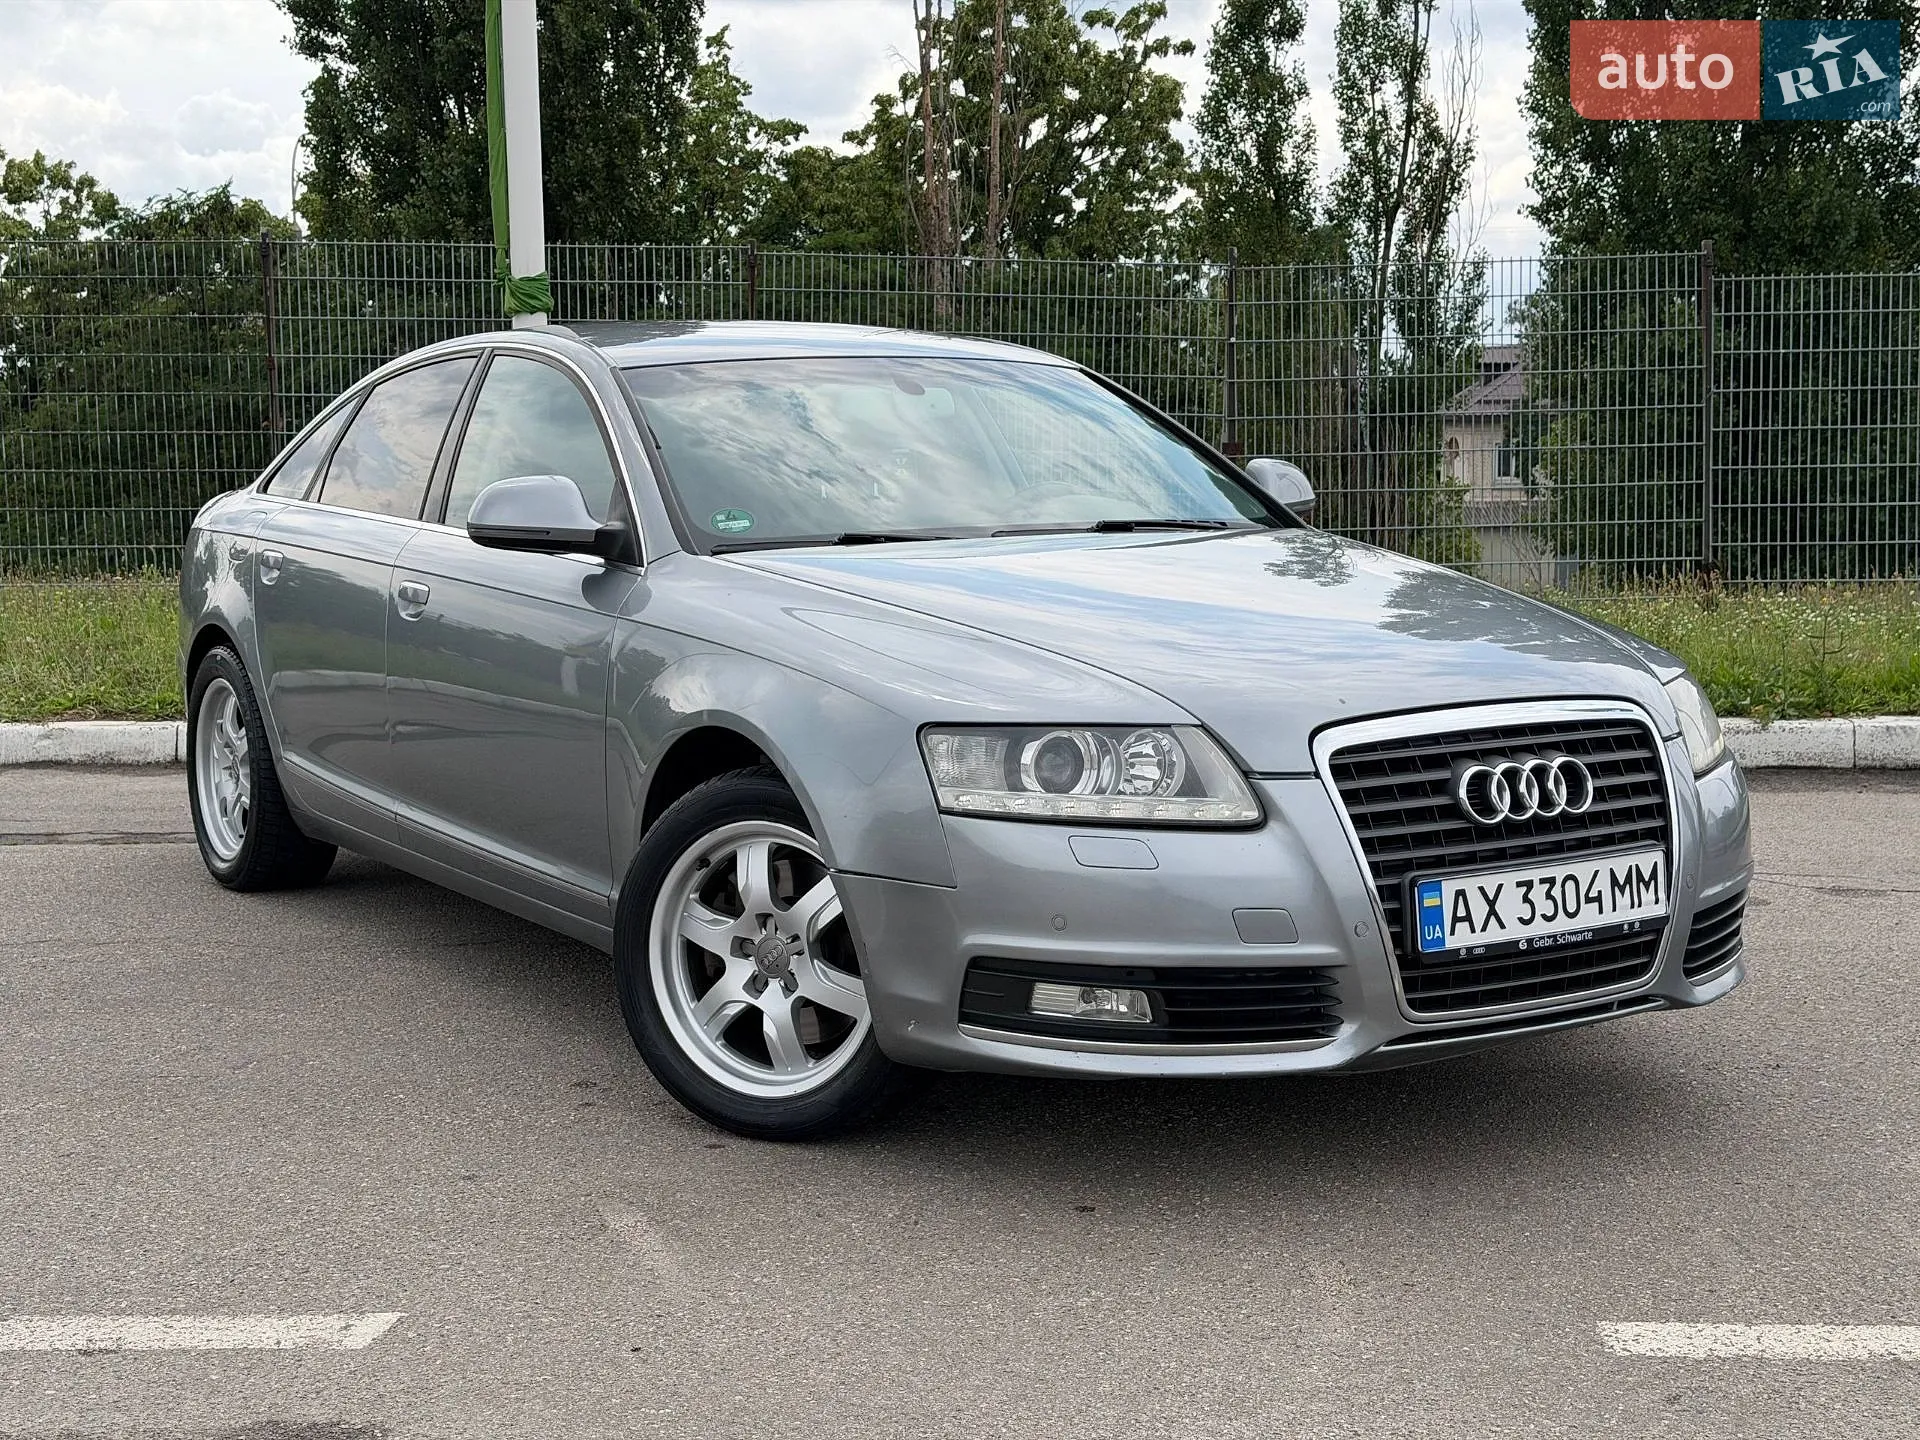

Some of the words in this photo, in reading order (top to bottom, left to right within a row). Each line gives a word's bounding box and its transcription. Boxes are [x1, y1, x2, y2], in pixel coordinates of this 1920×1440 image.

[1449, 883, 1507, 937] AX
[1515, 869, 1604, 926] 3304
[1609, 860, 1660, 913] MM
[1424, 926, 1442, 940] UA
[1533, 937, 1555, 948] Gebr.
[1556, 930, 1593, 945] Schwarte
